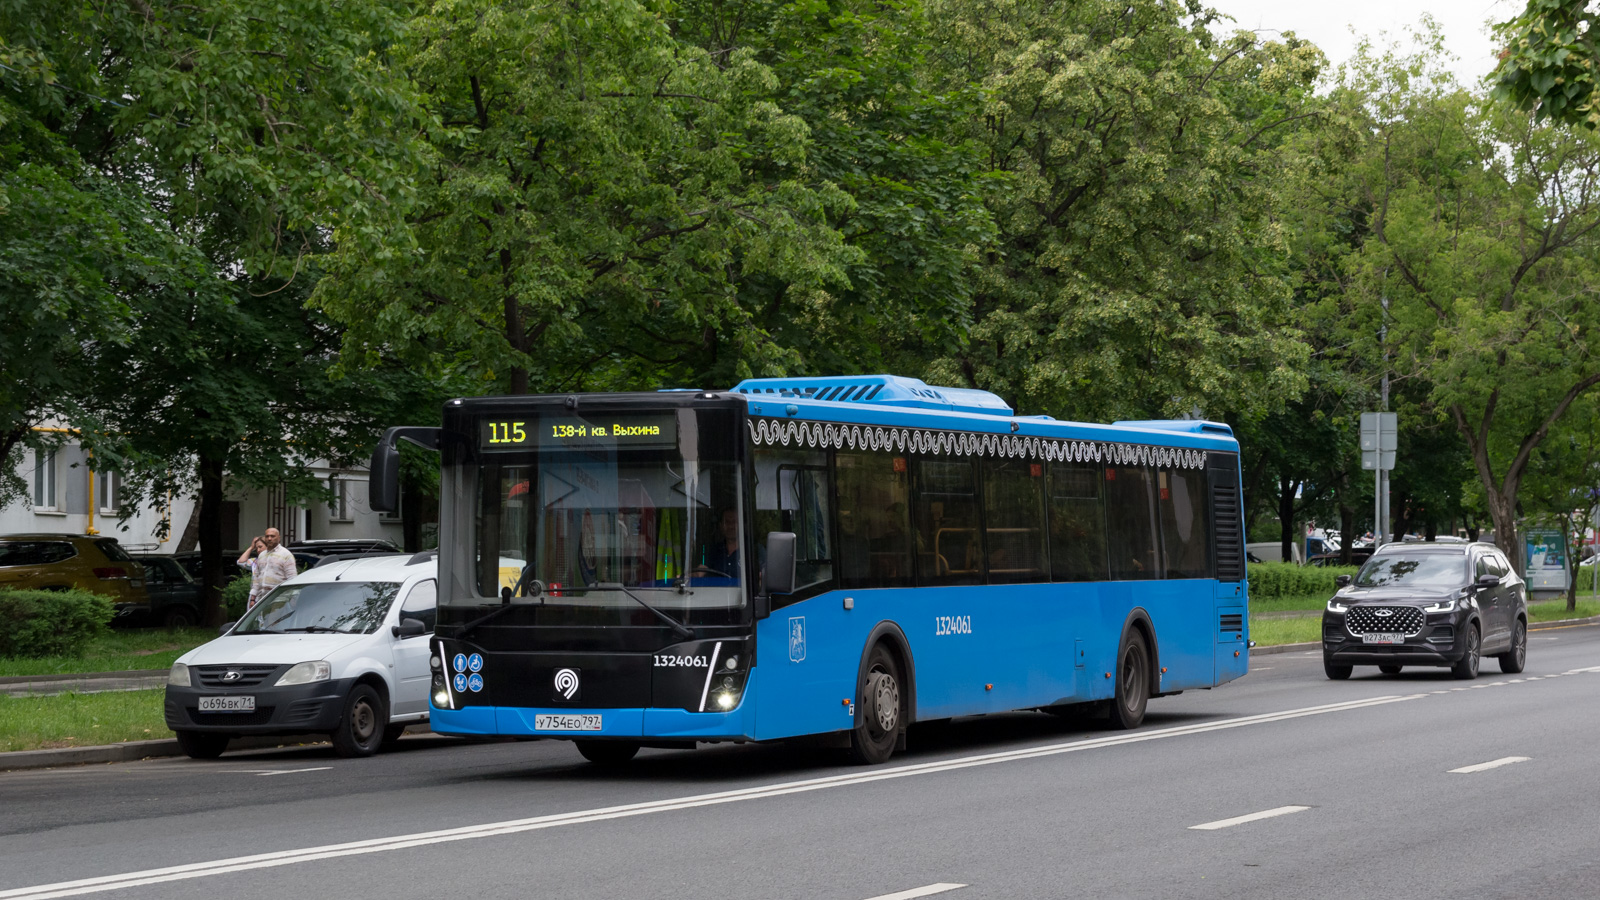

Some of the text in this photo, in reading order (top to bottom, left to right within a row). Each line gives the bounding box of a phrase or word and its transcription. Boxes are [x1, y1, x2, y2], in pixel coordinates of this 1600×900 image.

[489, 422, 526, 443] 115
[552, 424, 660, 437] 138-й кв. Выхина
[935, 615, 972, 636] 1324061
[653, 655, 709, 667] 1324061
[582, 716, 599, 726] 797
